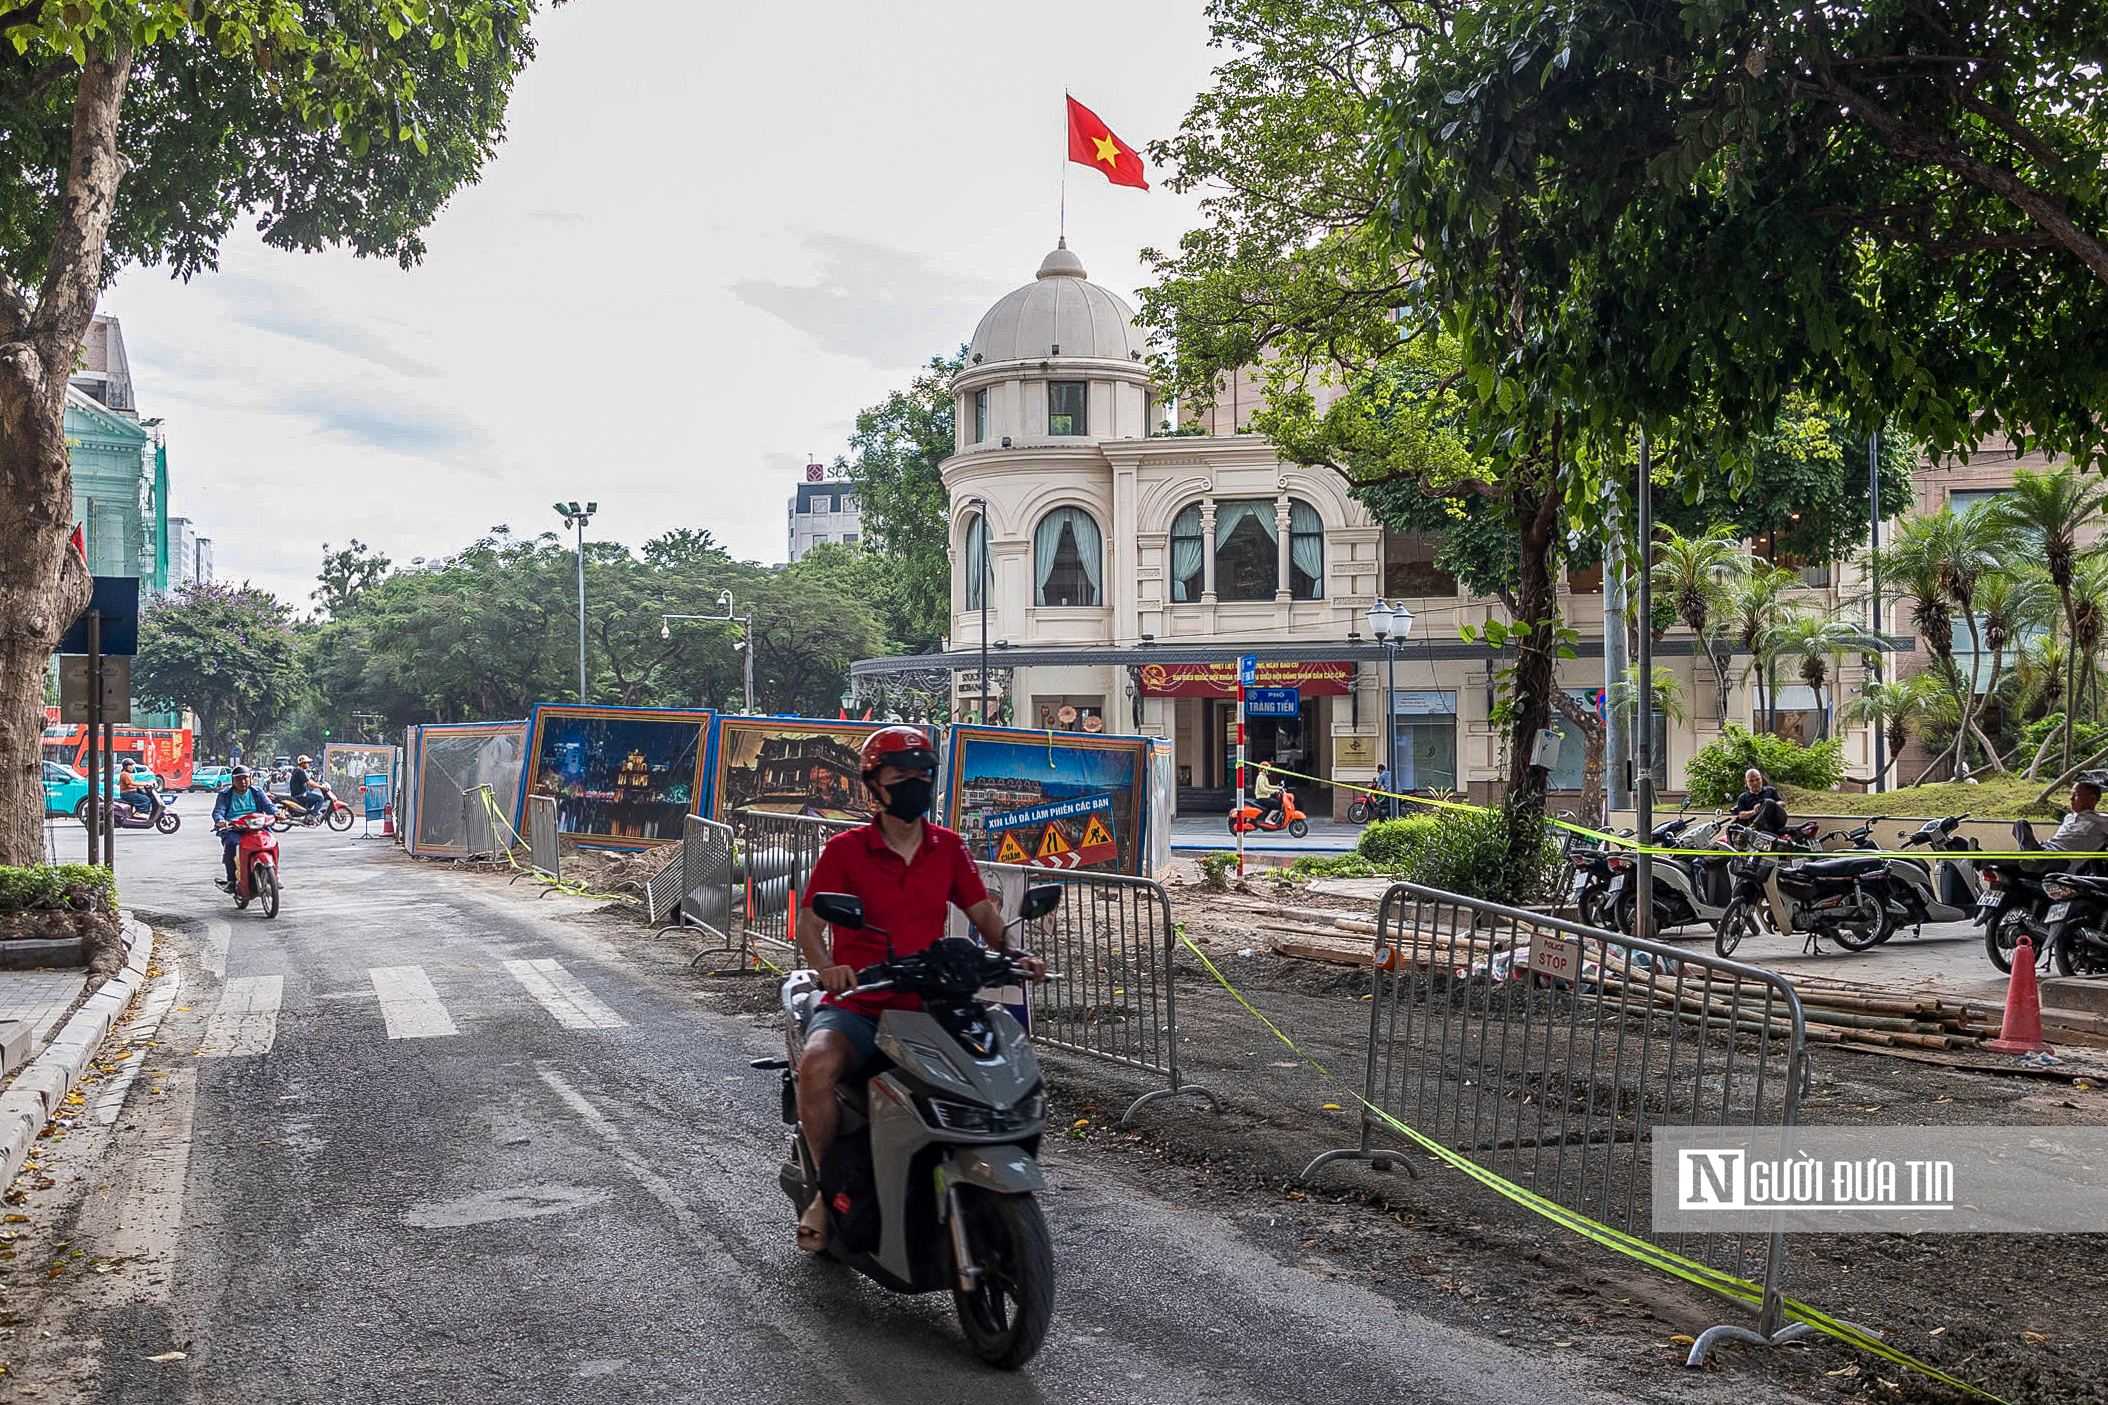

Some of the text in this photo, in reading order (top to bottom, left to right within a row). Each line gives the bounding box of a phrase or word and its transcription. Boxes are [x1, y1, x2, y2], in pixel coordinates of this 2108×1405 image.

[1268, 690, 1285, 698] PHỐ
[1249, 698, 1294, 712] TRÀNG TIẾN
[988, 818, 1003, 829] XIN
[1032, 808, 1049, 821] LÀM
[1050, 803, 1074, 817] PHIỀN
[1075, 800, 1091, 812] CÁC
[1093, 797, 1109, 810] BẠN
[1544, 940, 1565, 951] POLICE
[1539, 952, 1567, 970] STOP
